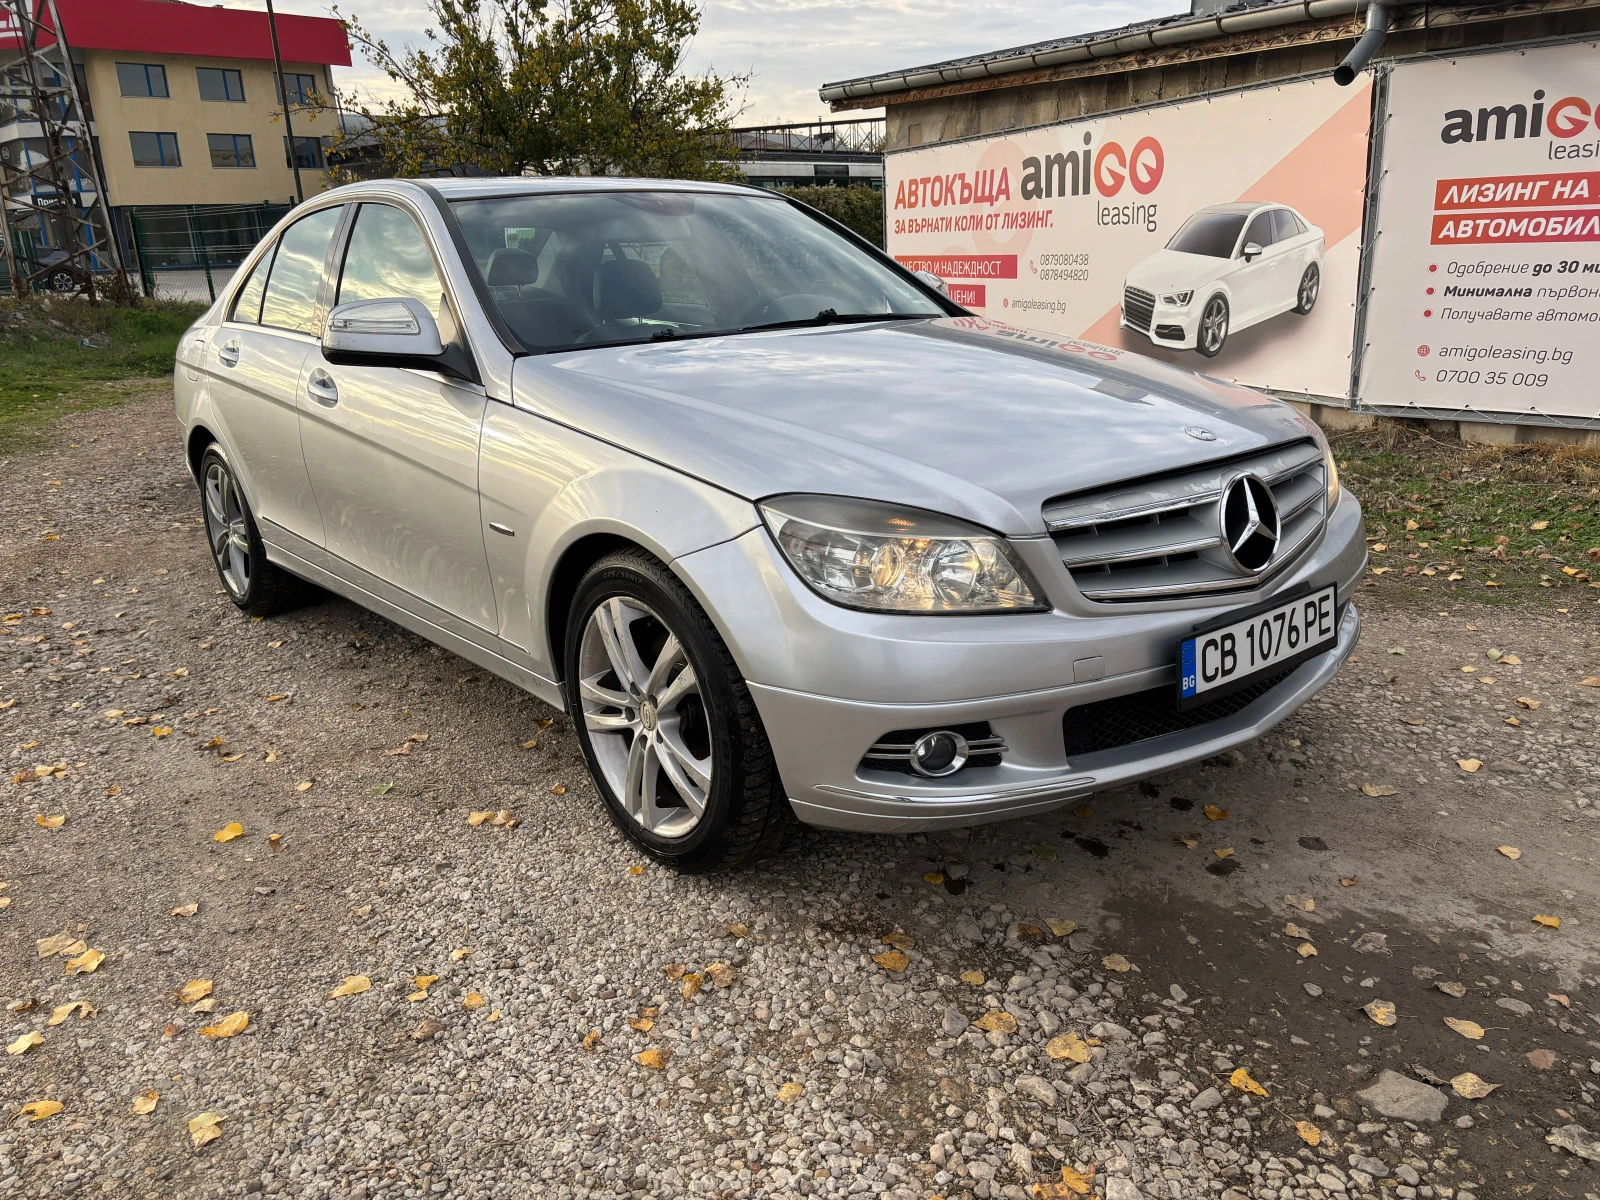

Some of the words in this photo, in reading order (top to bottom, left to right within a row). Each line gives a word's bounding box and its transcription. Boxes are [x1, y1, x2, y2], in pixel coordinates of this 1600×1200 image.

[1440, 89, 1600, 144] amiG
[894, 167, 1011, 209] АВТОКЪЩА
[1441, 181, 1549, 204] ЛИЗИНГ
[1551, 178, 1589, 200] НА
[894, 219, 906, 234] ЗА
[908, 216, 952, 234] ВЪРНАТИ
[954, 214, 983, 232] КОЛИ
[985, 213, 1001, 231] ОТ
[1001, 209, 1053, 230] ЛИЗИНГ.
[1097, 200, 1157, 232] leasing
[1040, 254, 1089, 266] 0879080438
[1447, 261, 1529, 277] Одобрение
[1531, 263, 1553, 277] до
[1556, 260, 1580, 273] 30
[933, 261, 939, 274] И
[941, 261, 1001, 277] НАДЕЖДНОСТ
[1040, 268, 1089, 281] 0878494820
[1443, 285, 1533, 298] Минимална
[1537, 285, 1600, 301] първон
[1011, 298, 1066, 314] amigoleasing.bg
[1440, 308, 1533, 323] Получавате
[1536, 308, 1600, 322] автомо
[1439, 345, 1573, 365] amigoleasing.bg
[1436, 370, 1480, 384] 0700
[1484, 371, 1508, 385] 35
[1512, 372, 1548, 387] 009
[1201, 632, 1237, 684] CB
[1246, 607, 1300, 667] 1076
[1304, 593, 1331, 643] PE
[1182, 675, 1195, 691] BG
